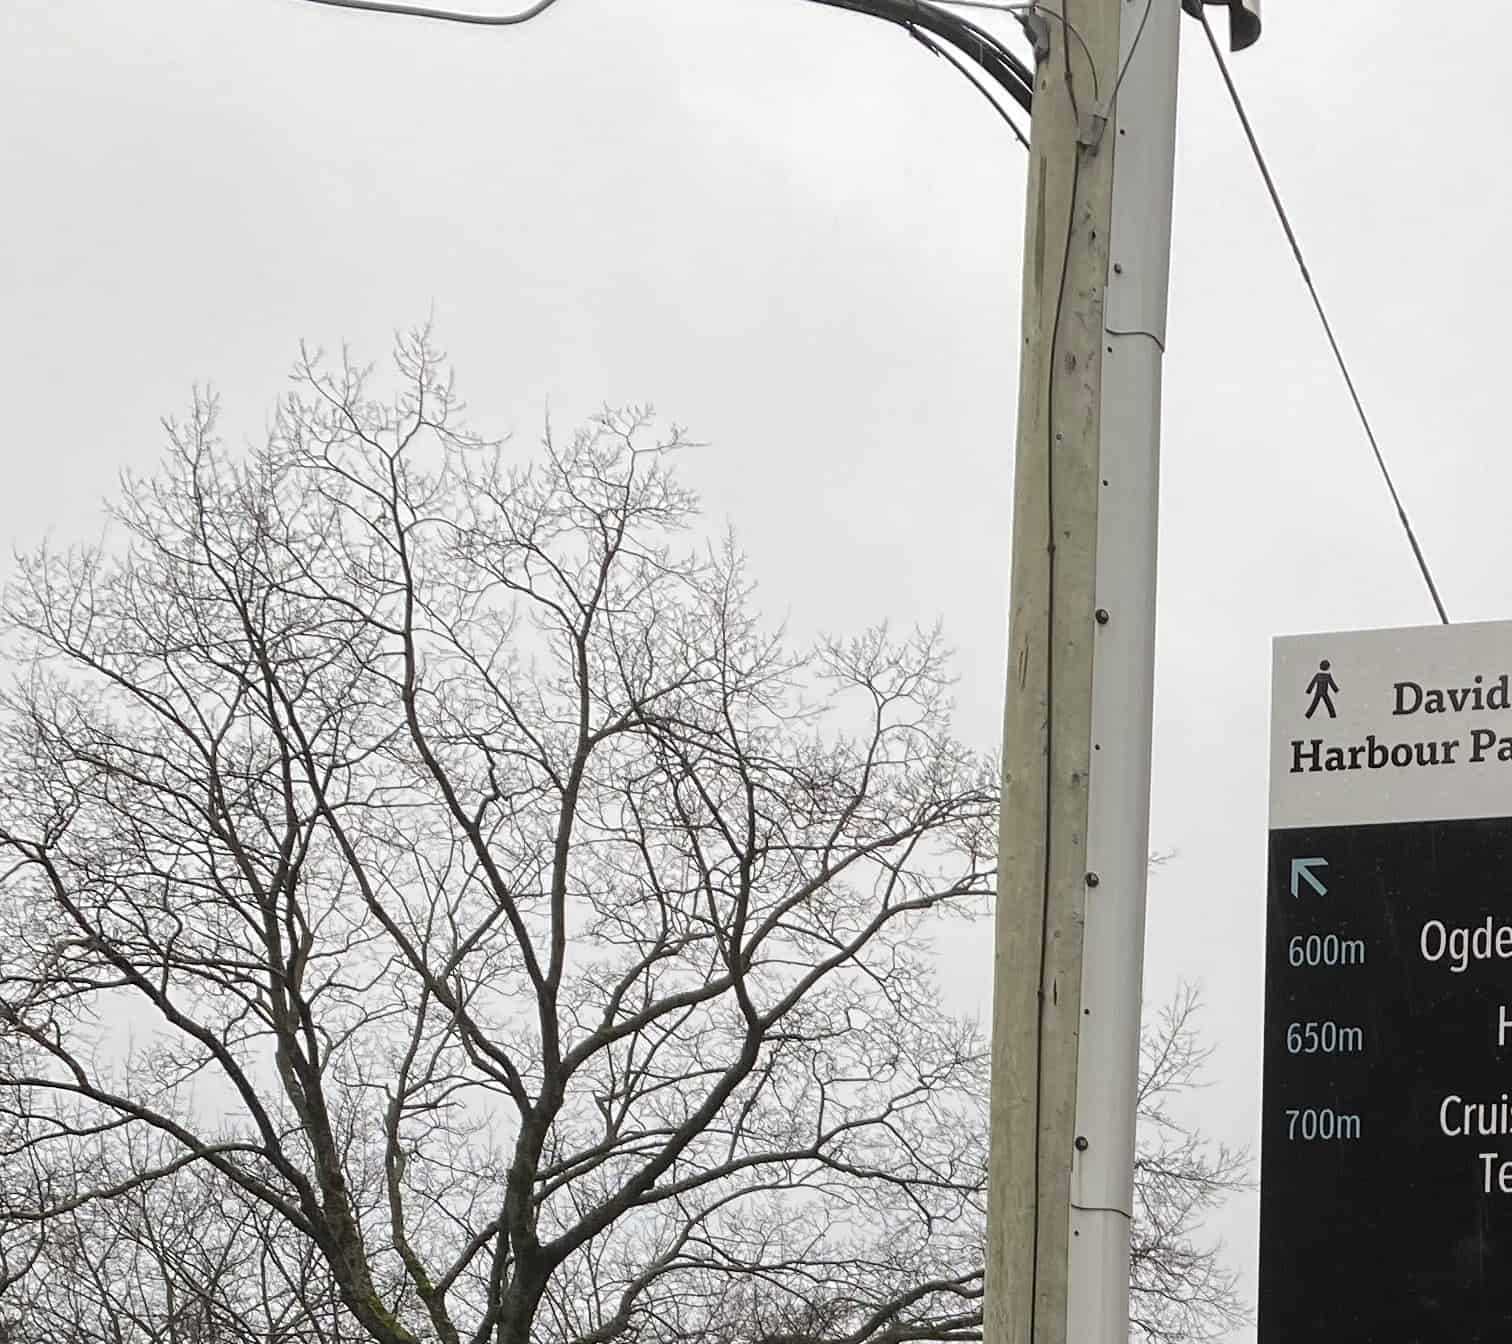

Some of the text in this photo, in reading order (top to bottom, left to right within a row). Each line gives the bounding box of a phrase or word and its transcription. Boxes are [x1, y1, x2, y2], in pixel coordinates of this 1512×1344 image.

[1392, 675, 1511, 716] David
[1289, 735, 1460, 774] Harbour
[1289, 934, 1365, 967] 600m
[1286, 1021, 1363, 1054] 650m
[1285, 1108, 1361, 1141] 700m
